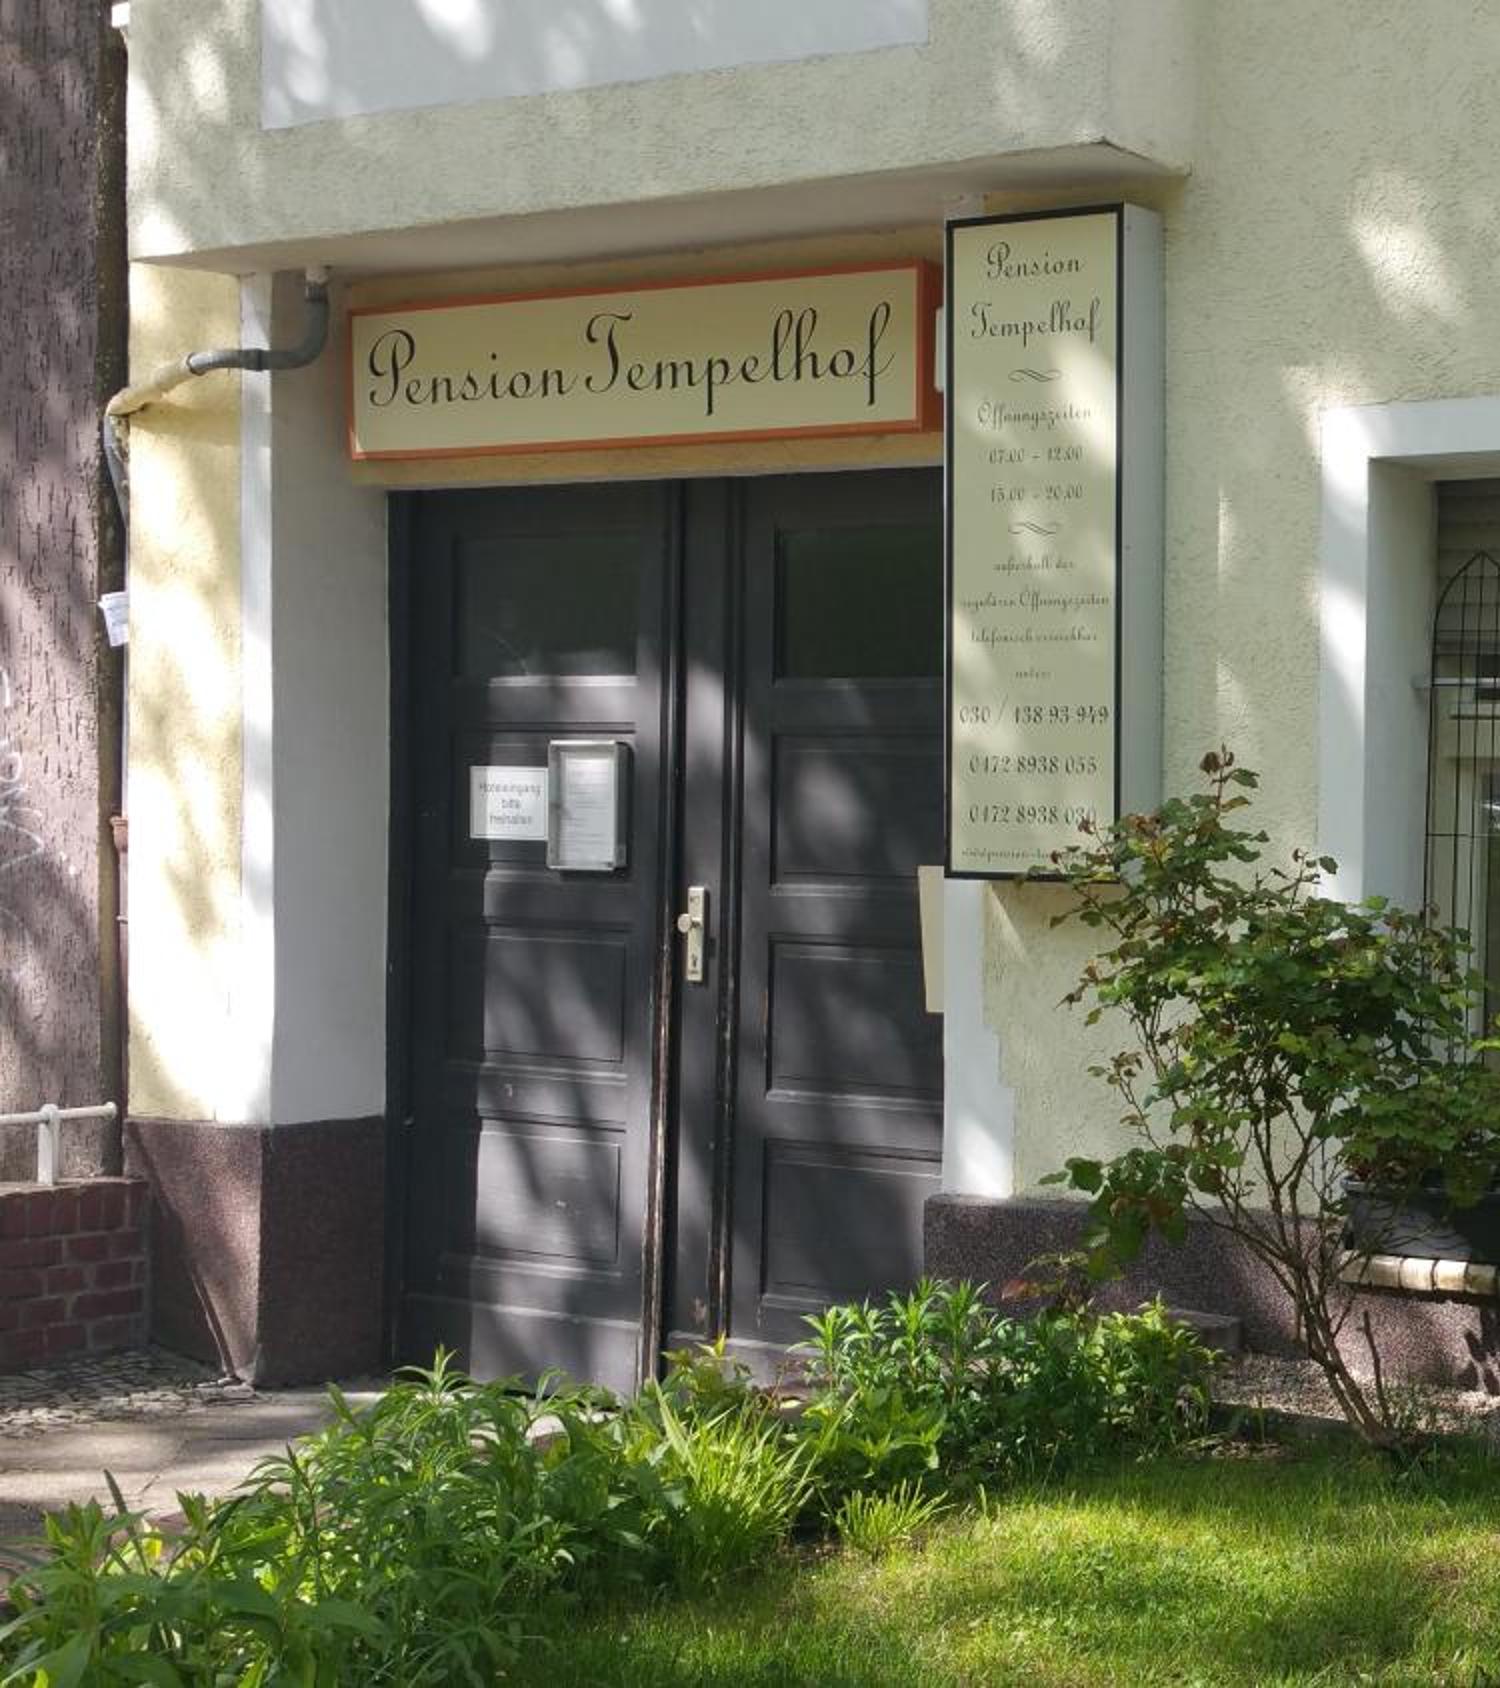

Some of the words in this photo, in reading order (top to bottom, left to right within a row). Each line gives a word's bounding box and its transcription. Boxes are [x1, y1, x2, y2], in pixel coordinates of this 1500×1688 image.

[986, 241, 1085, 280] Pension
[971, 297, 1100, 347] Tempelhof
[367, 328, 578, 407] Pension
[585, 301, 894, 416] Tempelhof
[959, 705, 991, 724] 030
[1049, 705, 1070, 724] 93
[1016, 755, 1060, 775] 8938
[1065, 755, 1098, 775] 055
[1015, 805, 1059, 824] 8938
